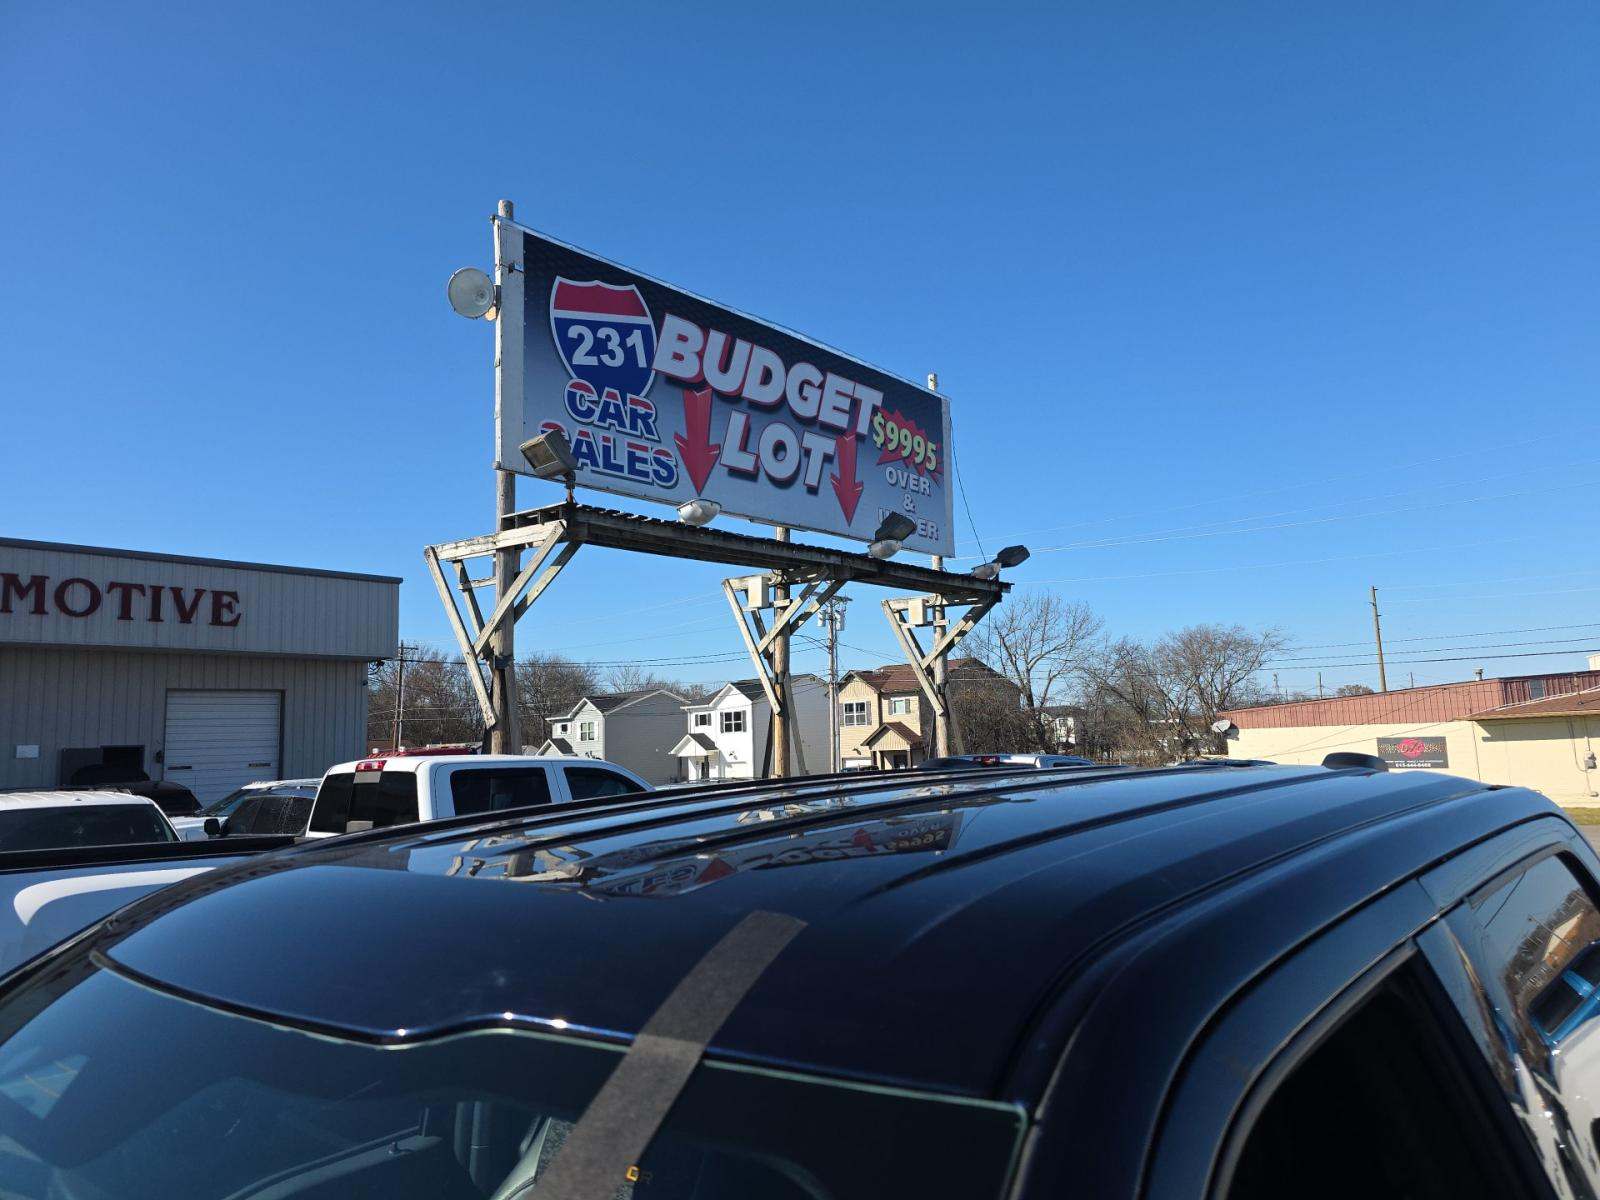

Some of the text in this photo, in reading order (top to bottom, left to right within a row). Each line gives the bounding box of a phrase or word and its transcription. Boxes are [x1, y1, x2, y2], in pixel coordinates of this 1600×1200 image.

[567, 324, 649, 369] 231
[652, 312, 884, 437] BUDGET
[563, 378, 661, 442] CAR
[720, 409, 836, 489] LOT
[873, 410, 938, 471] $9995
[885, 466, 930, 497] OVER
[903, 493, 916, 513] &
[0, 572, 242, 627] MOTIVE
